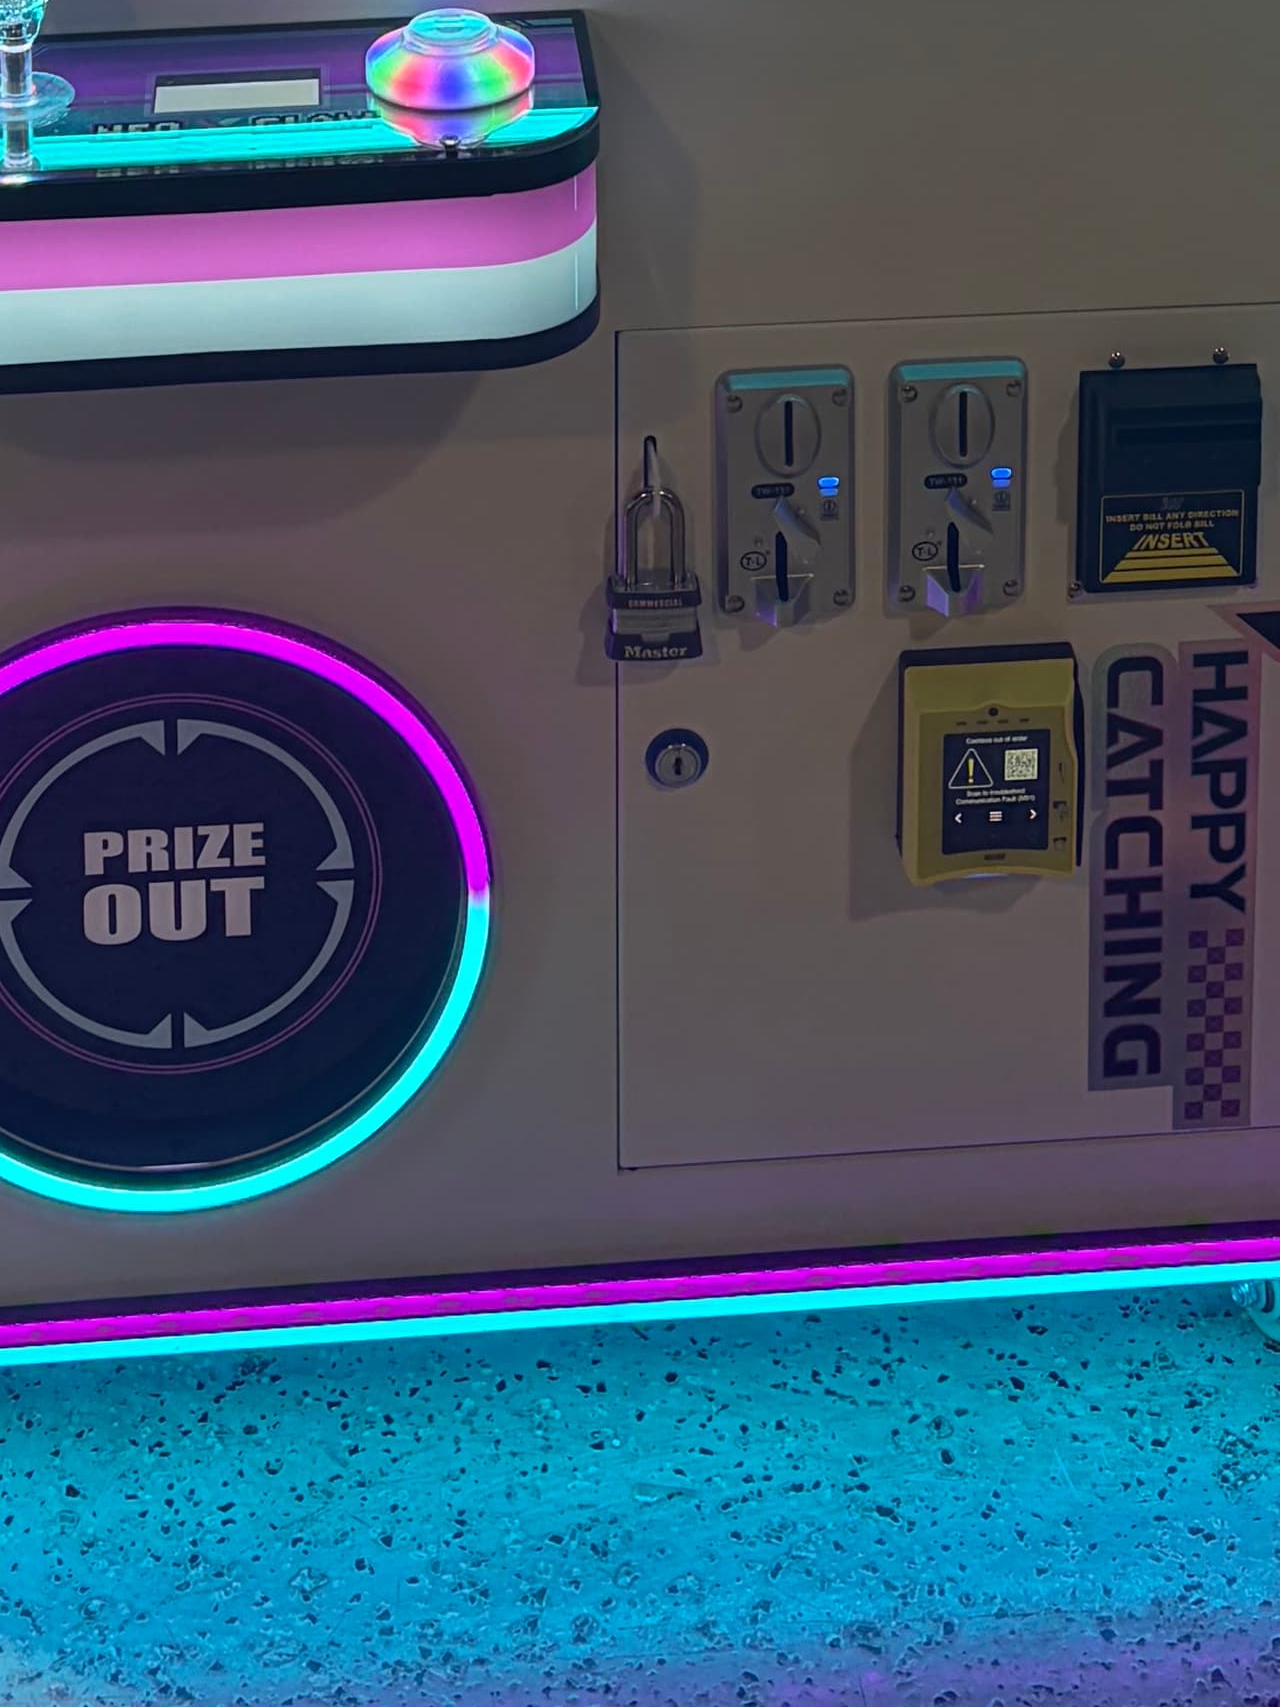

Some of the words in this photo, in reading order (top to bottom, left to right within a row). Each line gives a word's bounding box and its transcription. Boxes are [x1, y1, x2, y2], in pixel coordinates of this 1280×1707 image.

[1105, 513, 1141, 523] INSERT
[1142, 512, 1163, 522] BILL
[1166, 511, 1185, 521] ANY
[1187, 509, 1239, 520] DIRECTION
[1129, 523, 1143, 532] DO
[1145, 522, 1165, 531] NOT
[1167, 521, 1191, 530] FOLD
[1194, 520, 1214, 529] BILL
[1131, 531, 1210, 551] INSERT
[624, 646, 688, 659] Master
[1190, 649, 1251, 916] HAPPY
[83, 822, 266, 876] PRIZE
[1102, 653, 1165, 1079] CATCHING
[82, 877, 265, 946] OUT
